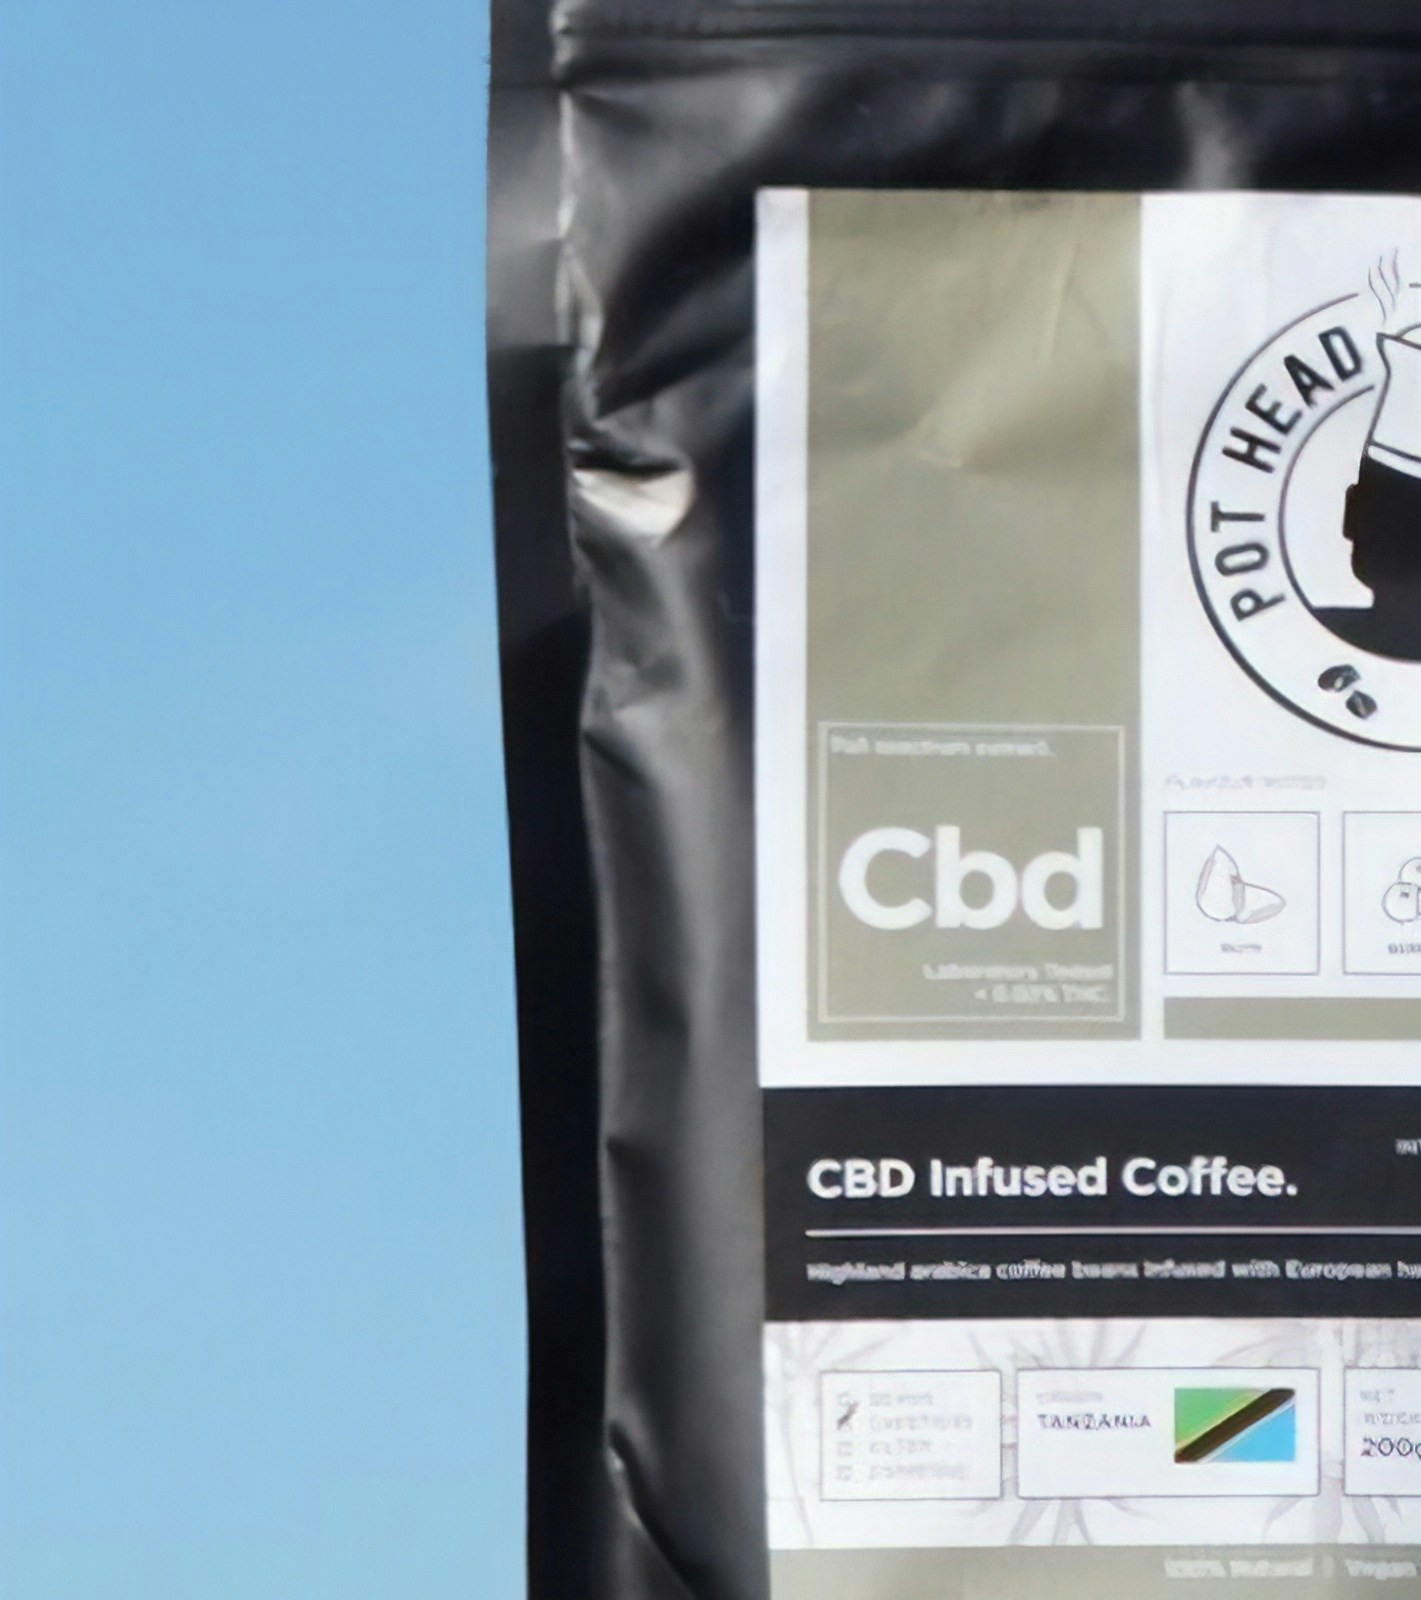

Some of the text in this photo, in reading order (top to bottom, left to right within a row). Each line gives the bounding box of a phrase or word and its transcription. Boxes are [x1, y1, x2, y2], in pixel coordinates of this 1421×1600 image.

[1209, 325, 1364, 622] POT HEAD
[837, 823, 1104, 931] Cbd
[806, 1154, 1299, 1199] CBD Infused Coffee.
